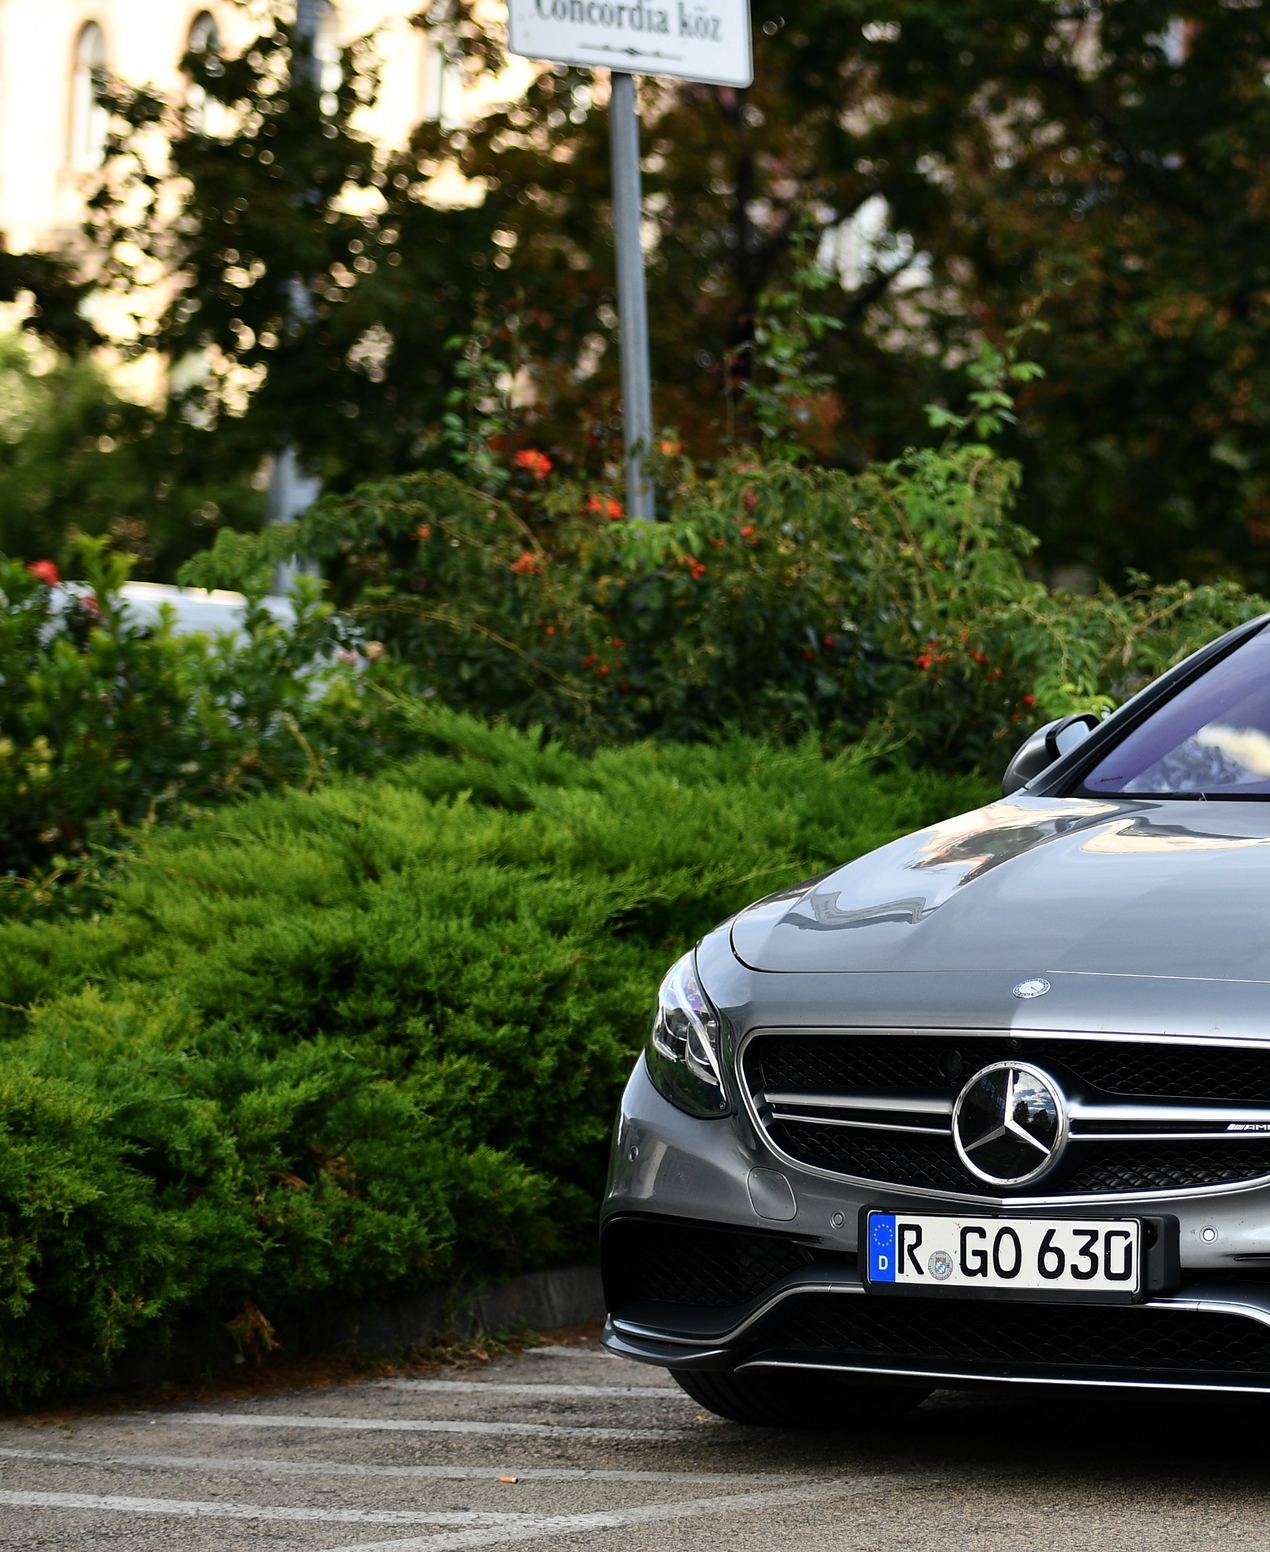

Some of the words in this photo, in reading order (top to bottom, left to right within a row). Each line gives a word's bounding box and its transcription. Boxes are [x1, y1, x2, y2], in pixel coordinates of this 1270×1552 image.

[534, 0, 670, 34] Concordia
[678, 2, 721, 41] köz
[878, 1255, 888, 1271] D
[897, 1223, 924, 1275] R
[960, 1223, 1022, 1280] GO
[1037, 1228, 1133, 1282] 630
